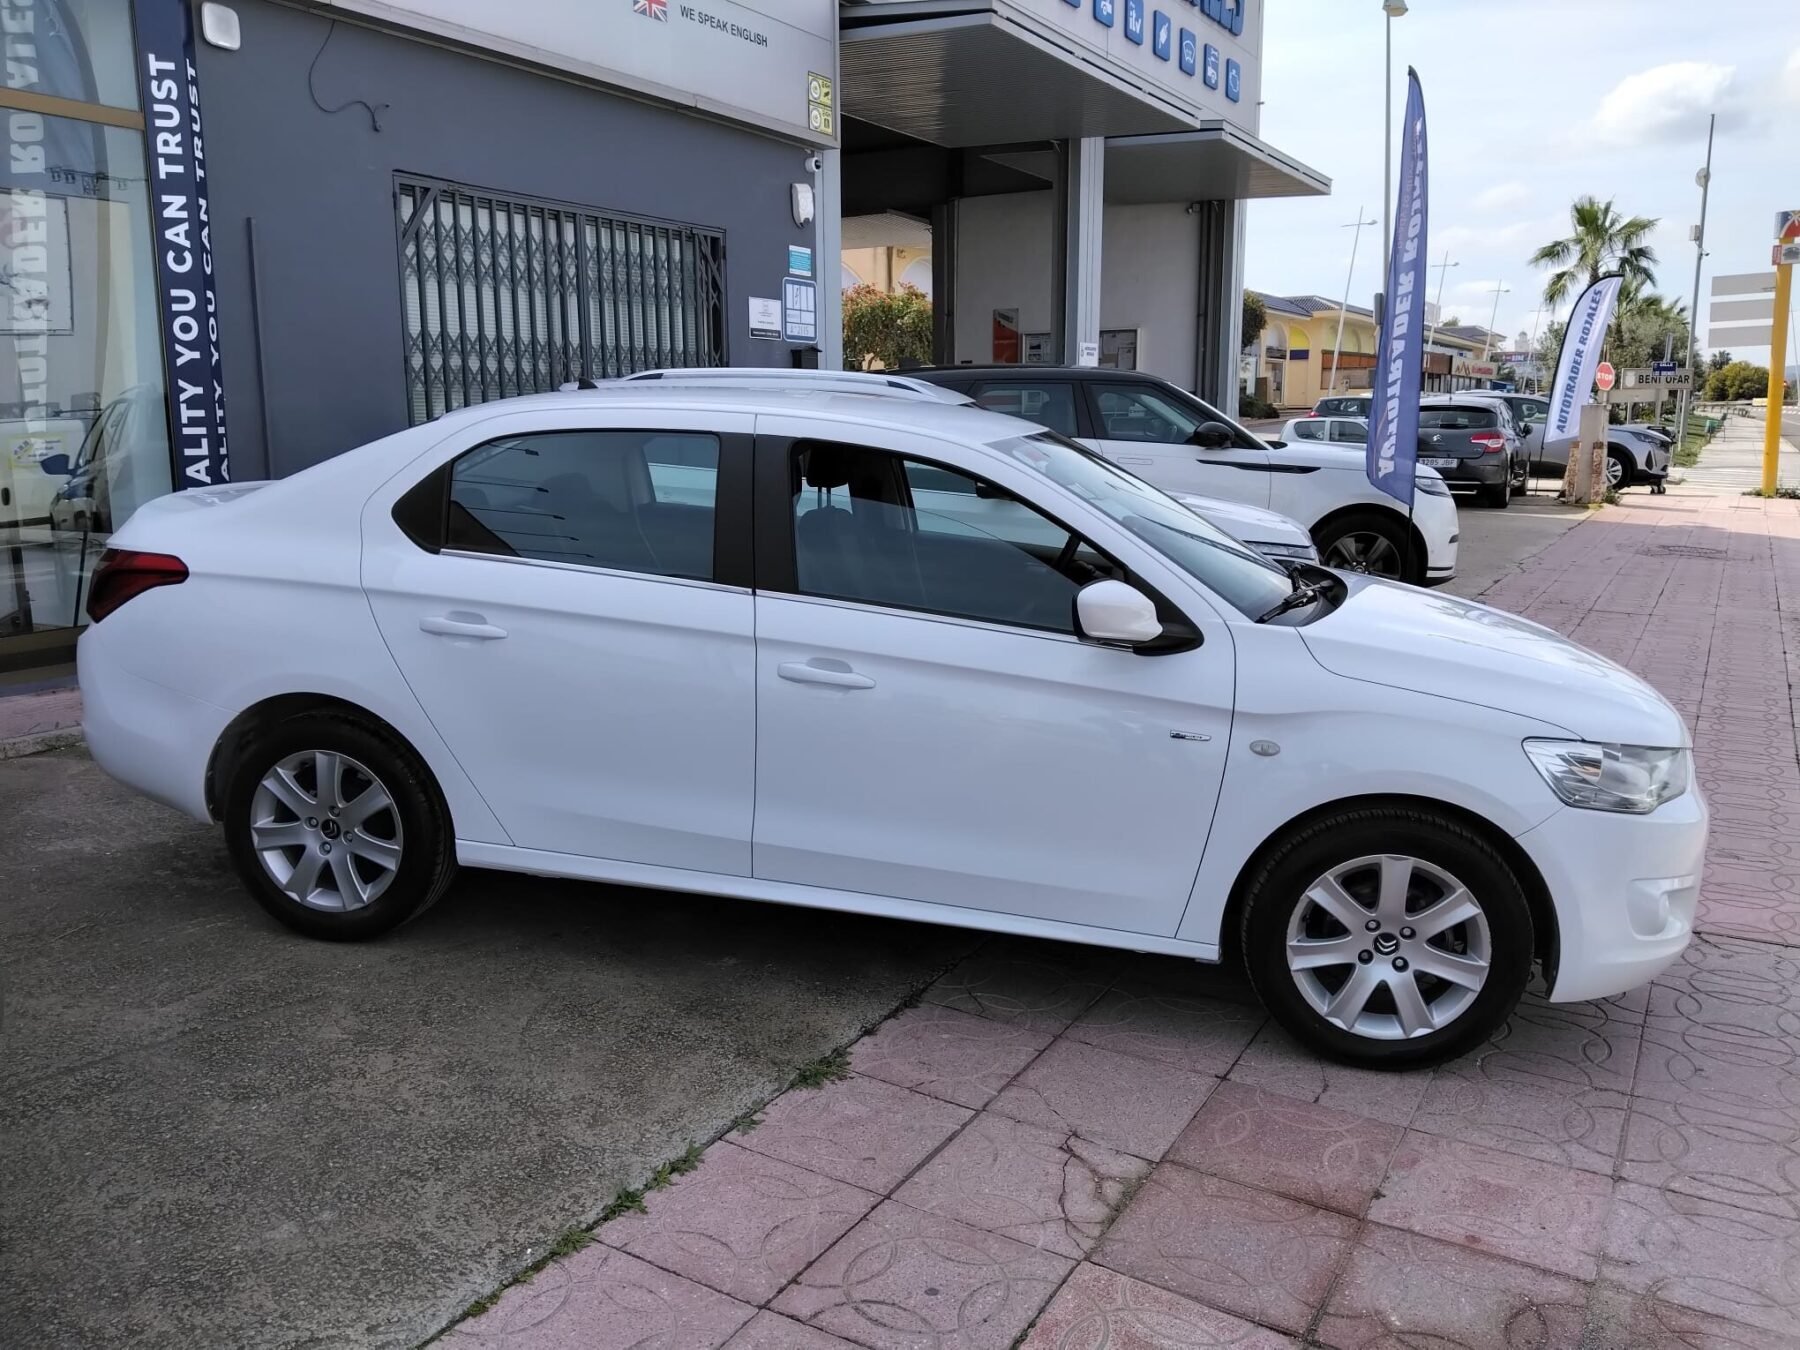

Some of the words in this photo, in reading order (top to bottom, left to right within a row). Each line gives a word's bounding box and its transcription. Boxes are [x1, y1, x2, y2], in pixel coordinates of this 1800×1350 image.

[680, 4, 696, 21] WE
[697, 11, 728, 34] SPEAK
[730, 23, 768, 48] ENGLISH
[148, 53, 185, 180] TRUST
[186, 58, 205, 182] TRUST
[160, 194, 194, 274] CAN
[198, 197, 213, 275] CAN
[169, 288, 201, 367] YOU
[205, 289, 220, 367] YOU
[1556, 348, 1585, 434] AUTOTRADER
[1578, 288, 1602, 347] ROJALES
[1597, 372, 1613, 381] STOP
[178, 378, 212, 485] ALITY
[212, 378, 231, 482] ALITY
